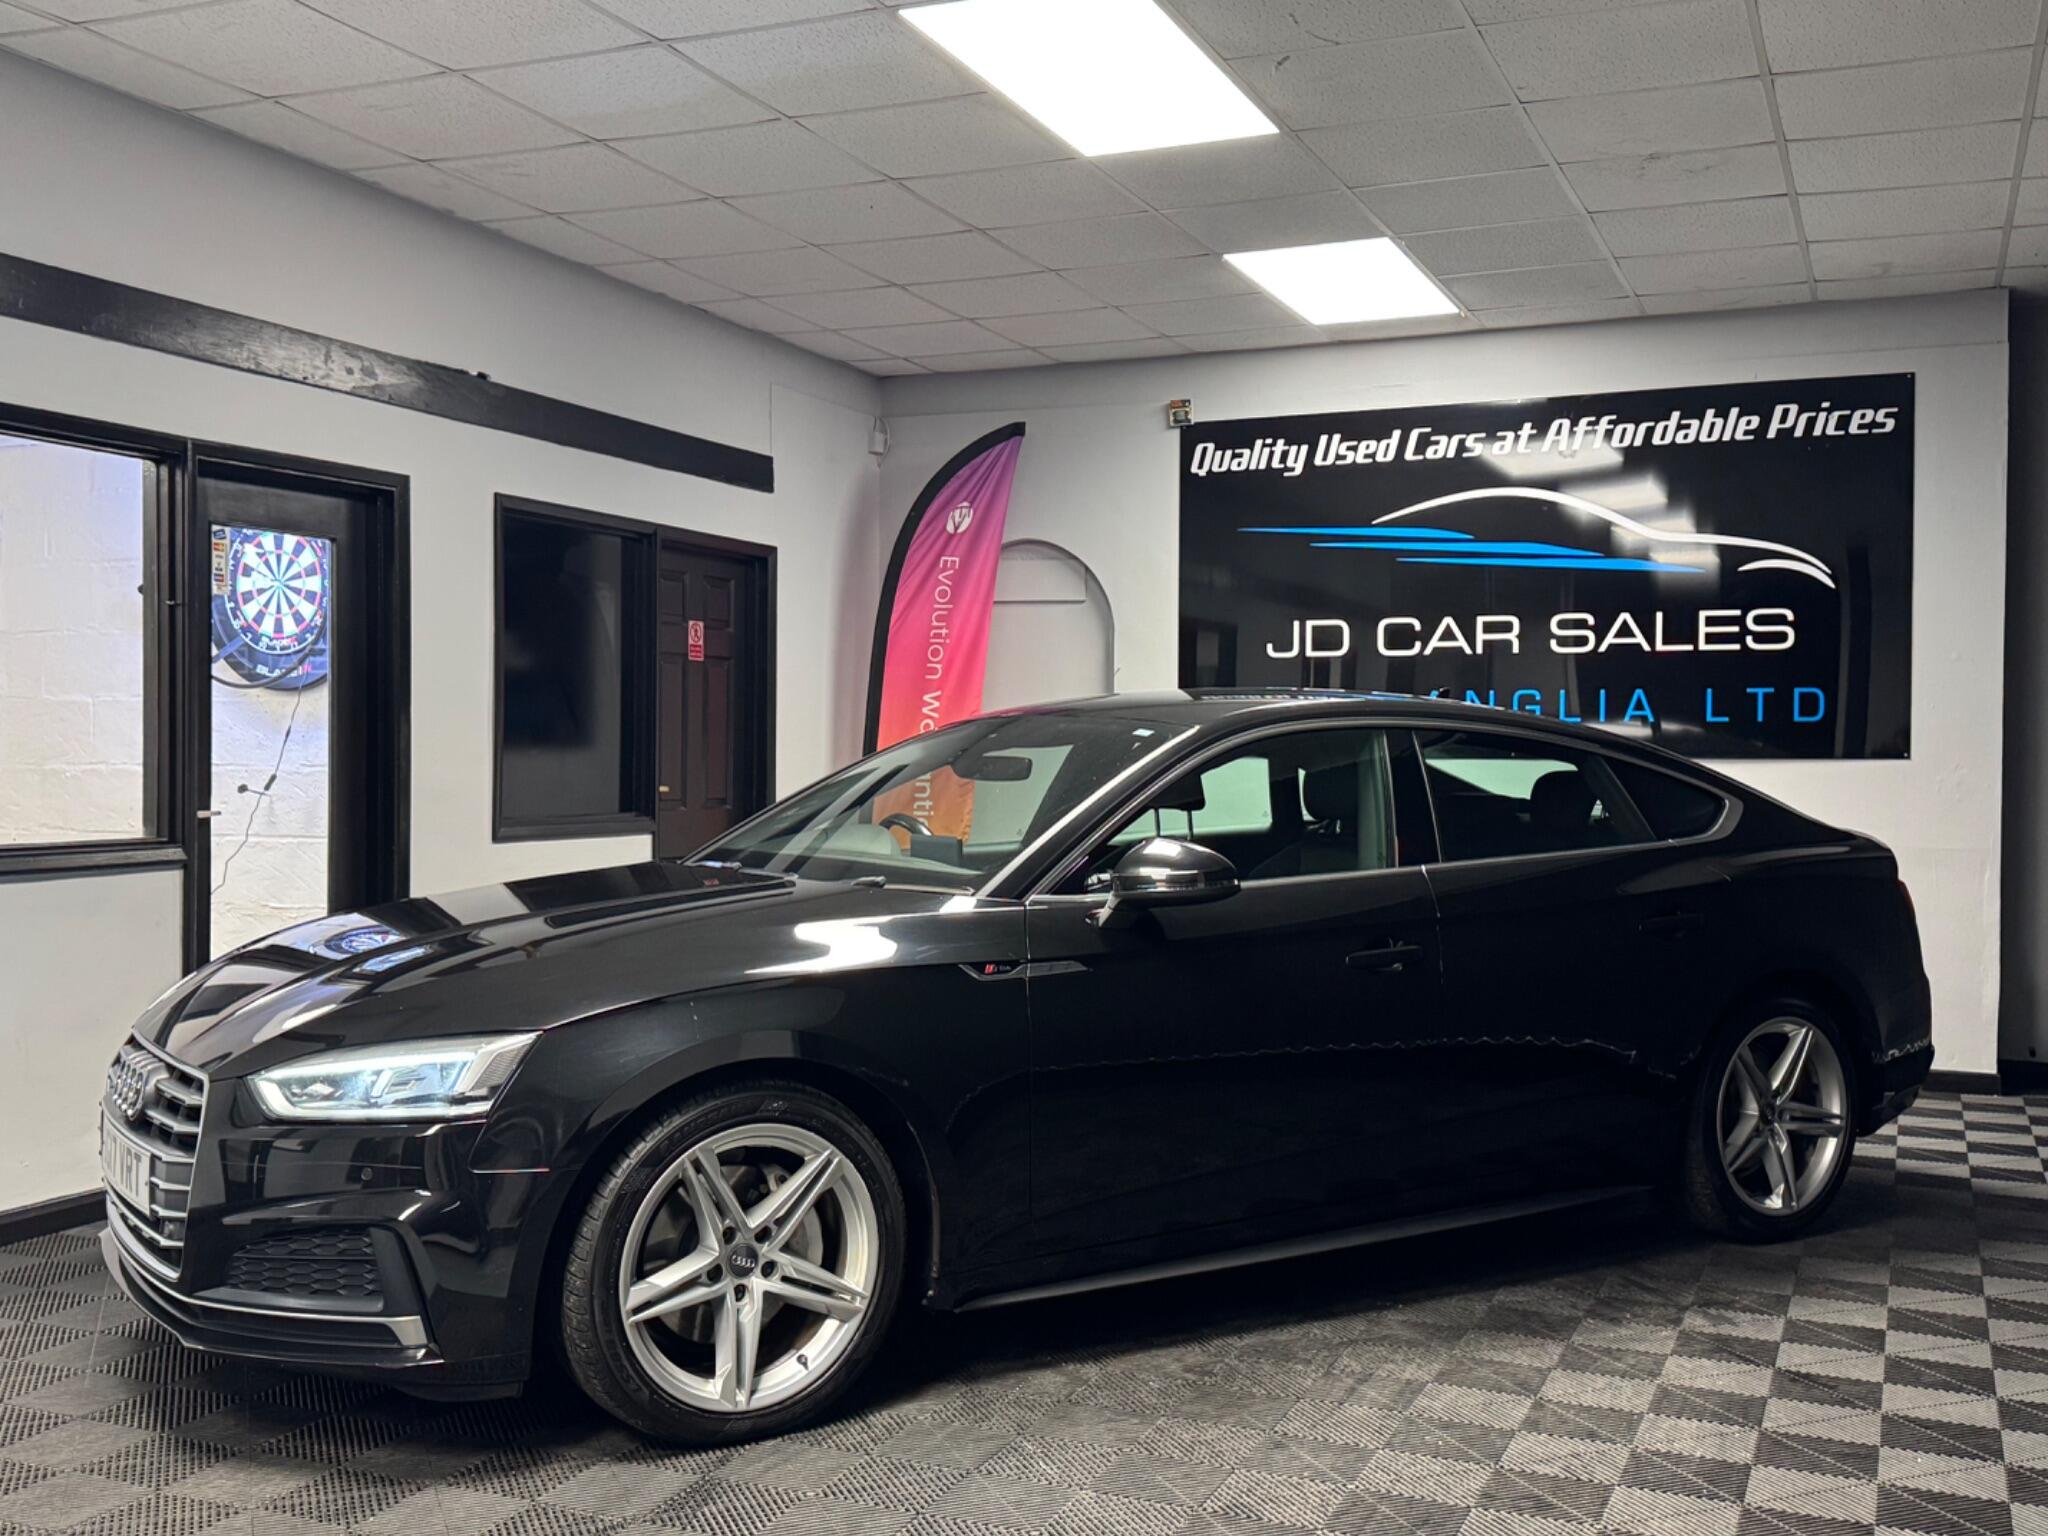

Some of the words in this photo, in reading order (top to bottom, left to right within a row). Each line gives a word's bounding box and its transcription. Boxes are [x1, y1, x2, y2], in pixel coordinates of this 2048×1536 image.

[1190, 438, 1308, 478] Quality
[1313, 430, 1402, 467] Used
[1403, 427, 1486, 461] Cars
[1491, 421, 1536, 454] at
[1541, 405, 1760, 452] Affordable
[1766, 401, 1899, 439] Prices
[926, 556, 960, 680] Evolution
[1266, 617, 1351, 659] JD
[1376, 613, 1520, 658] CAR
[1549, 607, 1796, 655] SALES
[1429, 688, 1656, 724] NGLIA
[1705, 687, 1826, 723] LTD
